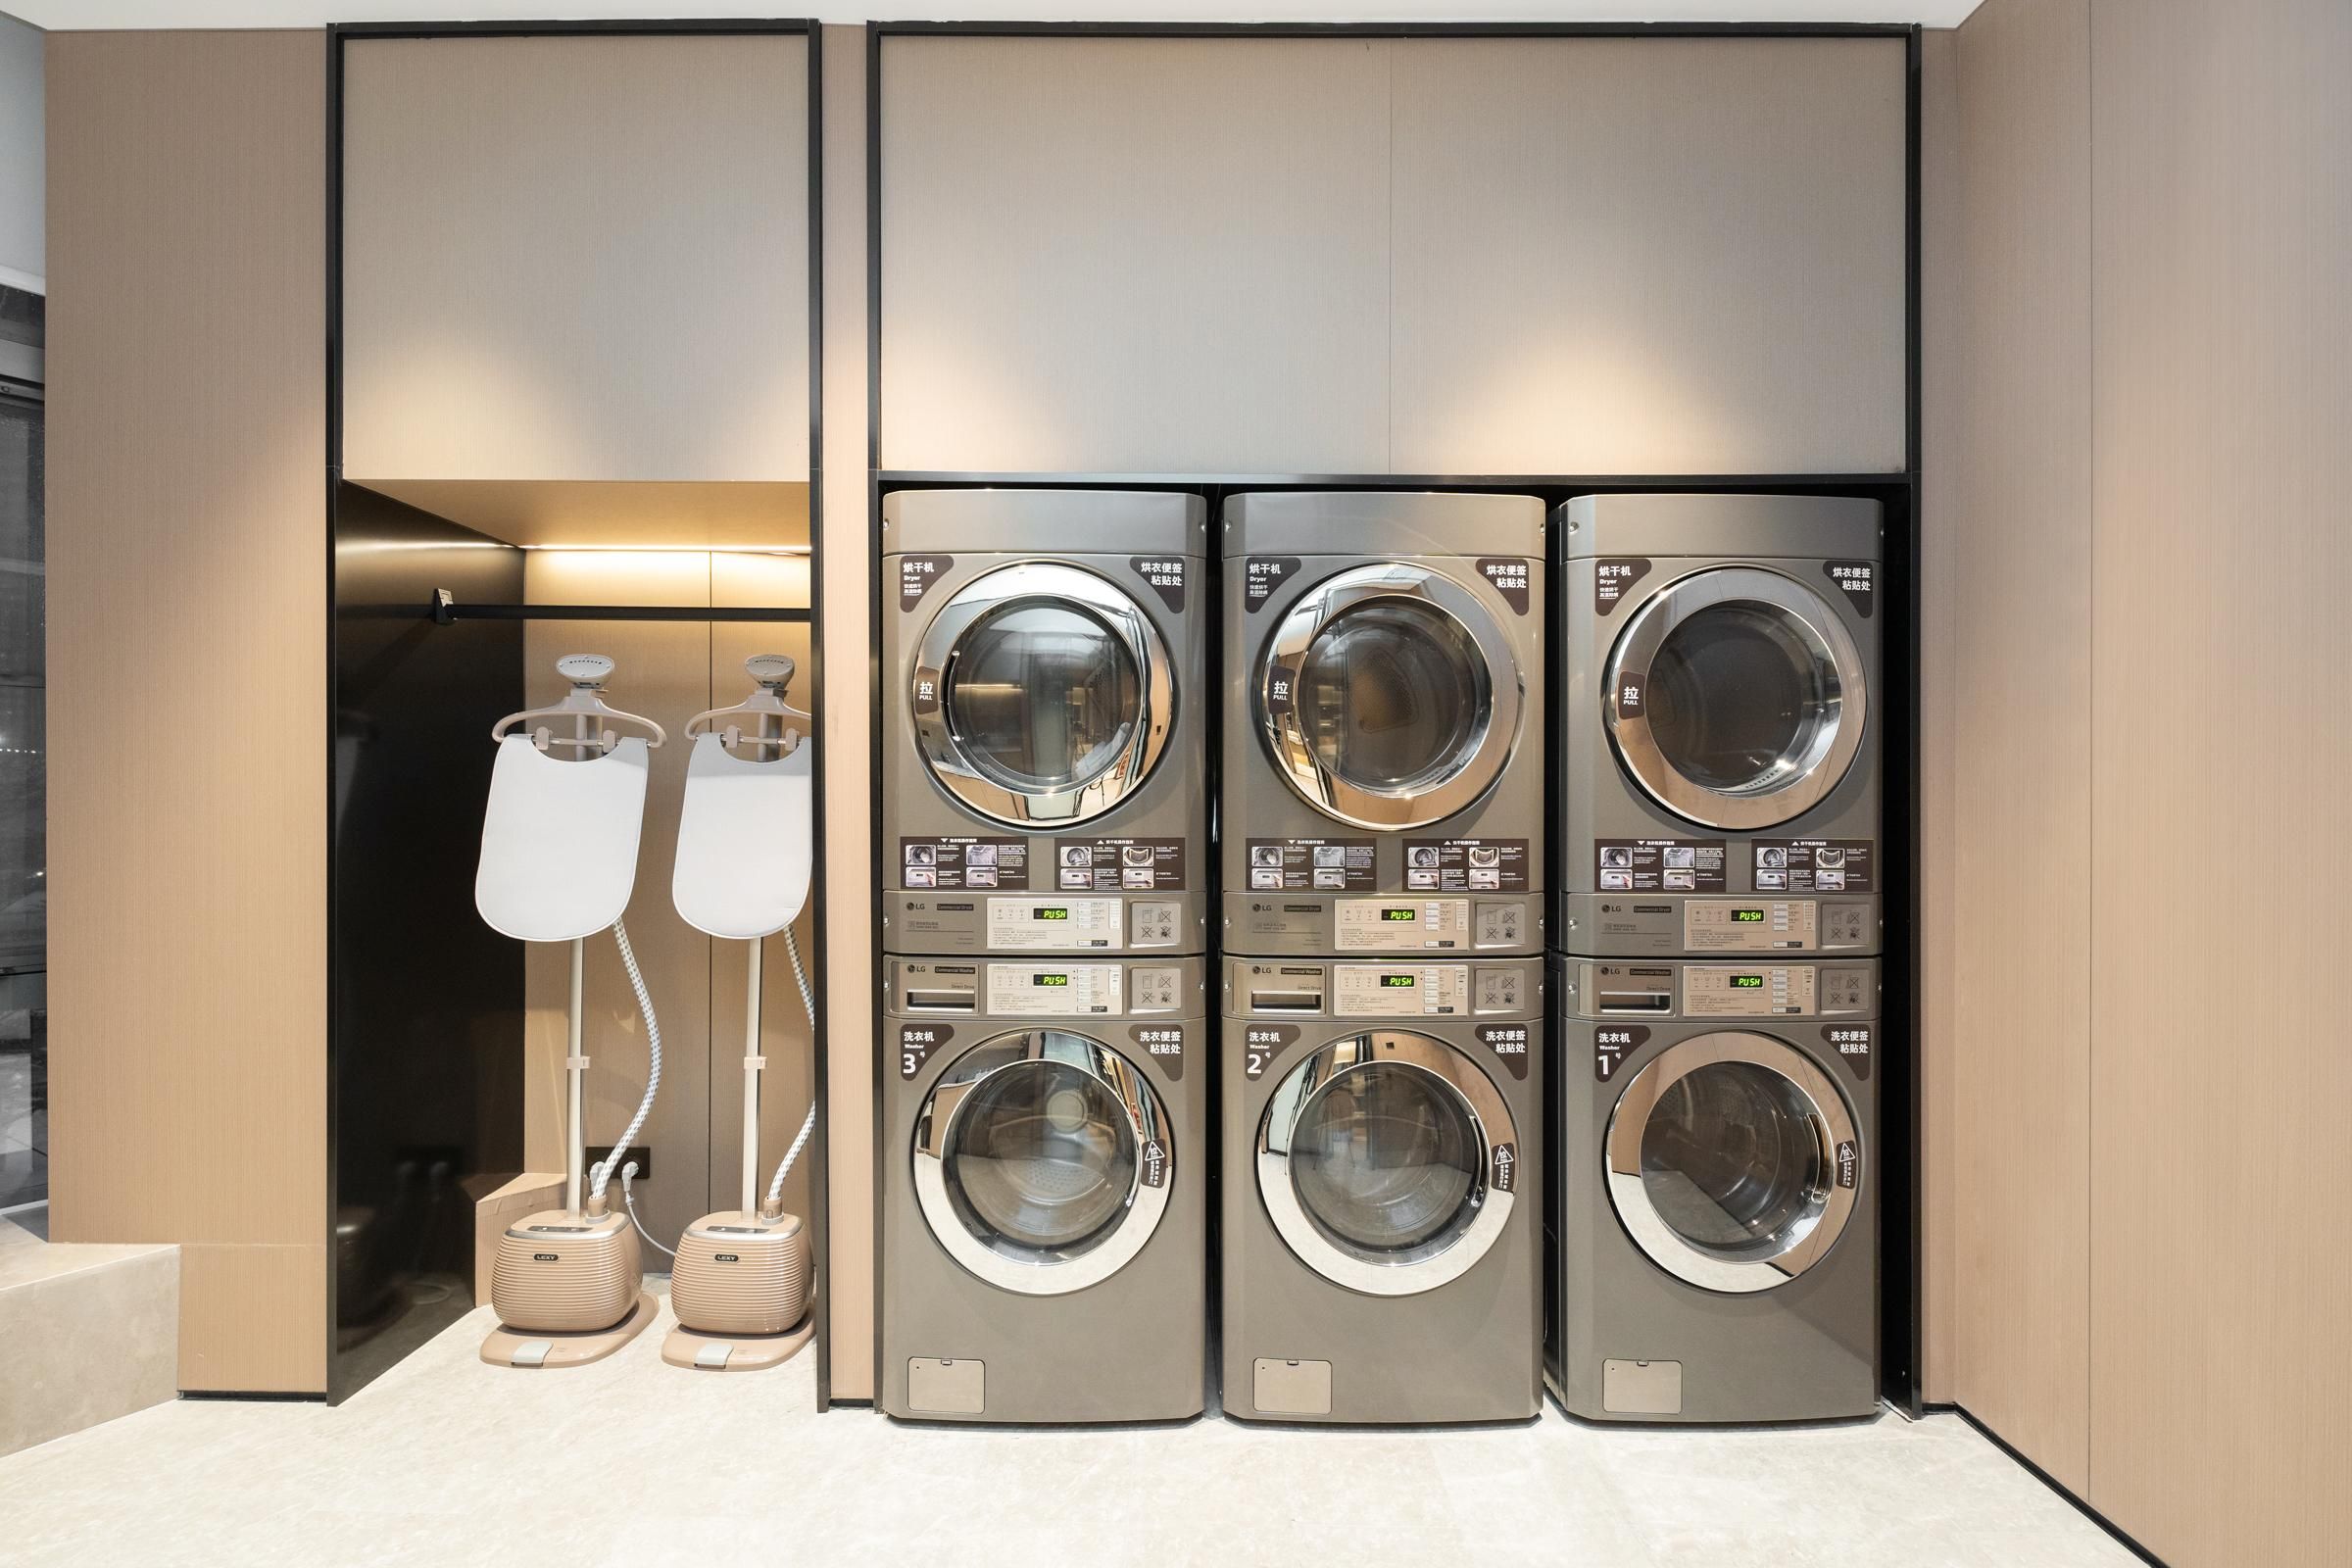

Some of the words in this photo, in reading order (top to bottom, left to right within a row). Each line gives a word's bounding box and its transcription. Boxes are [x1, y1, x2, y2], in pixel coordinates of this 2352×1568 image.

[904, 563, 934, 573] 烘干机
[1141, 563, 1182, 574] 烘衣便签
[1250, 564, 1281, 574] 烘干机
[1486, 564, 1526, 576] 烘衣便签
[1599, 565, 1631, 576] 烘干机
[1833, 567, 1871, 578] 烘衣便签
[1152, 575, 1182, 586] 粘贴处
[1496, 578, 1526, 588] 粘贴处
[1842, 580, 1870, 590] 粘贴处
[920, 681, 933, 694] 拉
[1274, 681, 1289, 694] 拉
[1624, 686, 1639, 700] 拉
[1044, 909, 1066, 919] PUSH
[1390, 910, 1413, 920] PUSH
[1739, 910, 1761, 920] PUSH
[1043, 976, 1066, 985] PUSH
[1389, 977, 1412, 986] PUSH
[1738, 977, 1760, 986] PUSH
[905, 1031, 934, 1042] 洗衣机
[1140, 1031, 1181, 1042] 洗衣便签
[1250, 1031, 1280, 1042] 洗衣机
[1487, 1030, 1526, 1041] 洗衣便签
[1599, 1032, 1630, 1043] 洗衣机
[1831, 1031, 1868, 1042] 洗衣便签
[1150, 1044, 1181, 1054] 粘贴处
[1495, 1043, 1526, 1054] 粘贴处
[1839, 1044, 1868, 1054] 粘贴处
